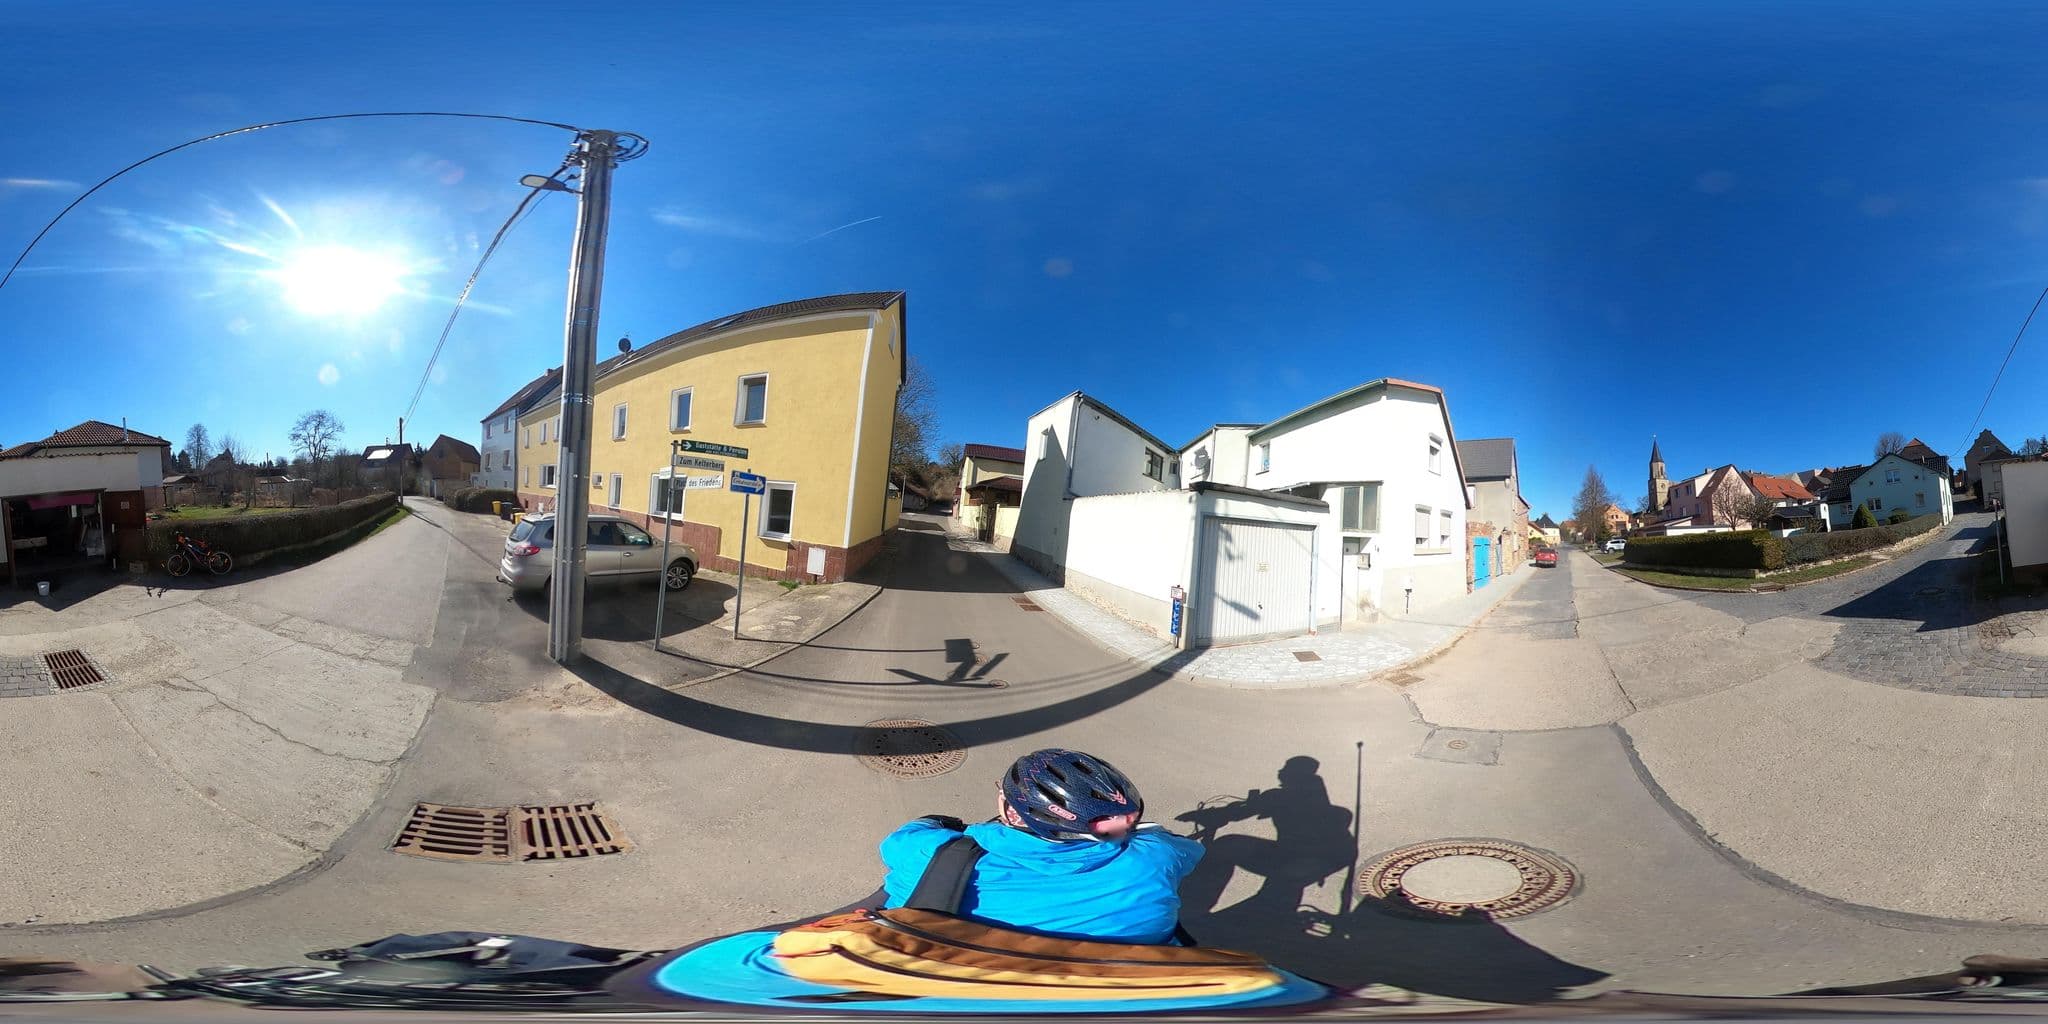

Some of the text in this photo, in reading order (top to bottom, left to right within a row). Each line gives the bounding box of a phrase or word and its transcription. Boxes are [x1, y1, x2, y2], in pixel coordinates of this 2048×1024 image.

[679, 456, 724, 470] Zum Kelterberg
[688, 479, 698, 487] des
[699, 477, 722, 487] Friedens
